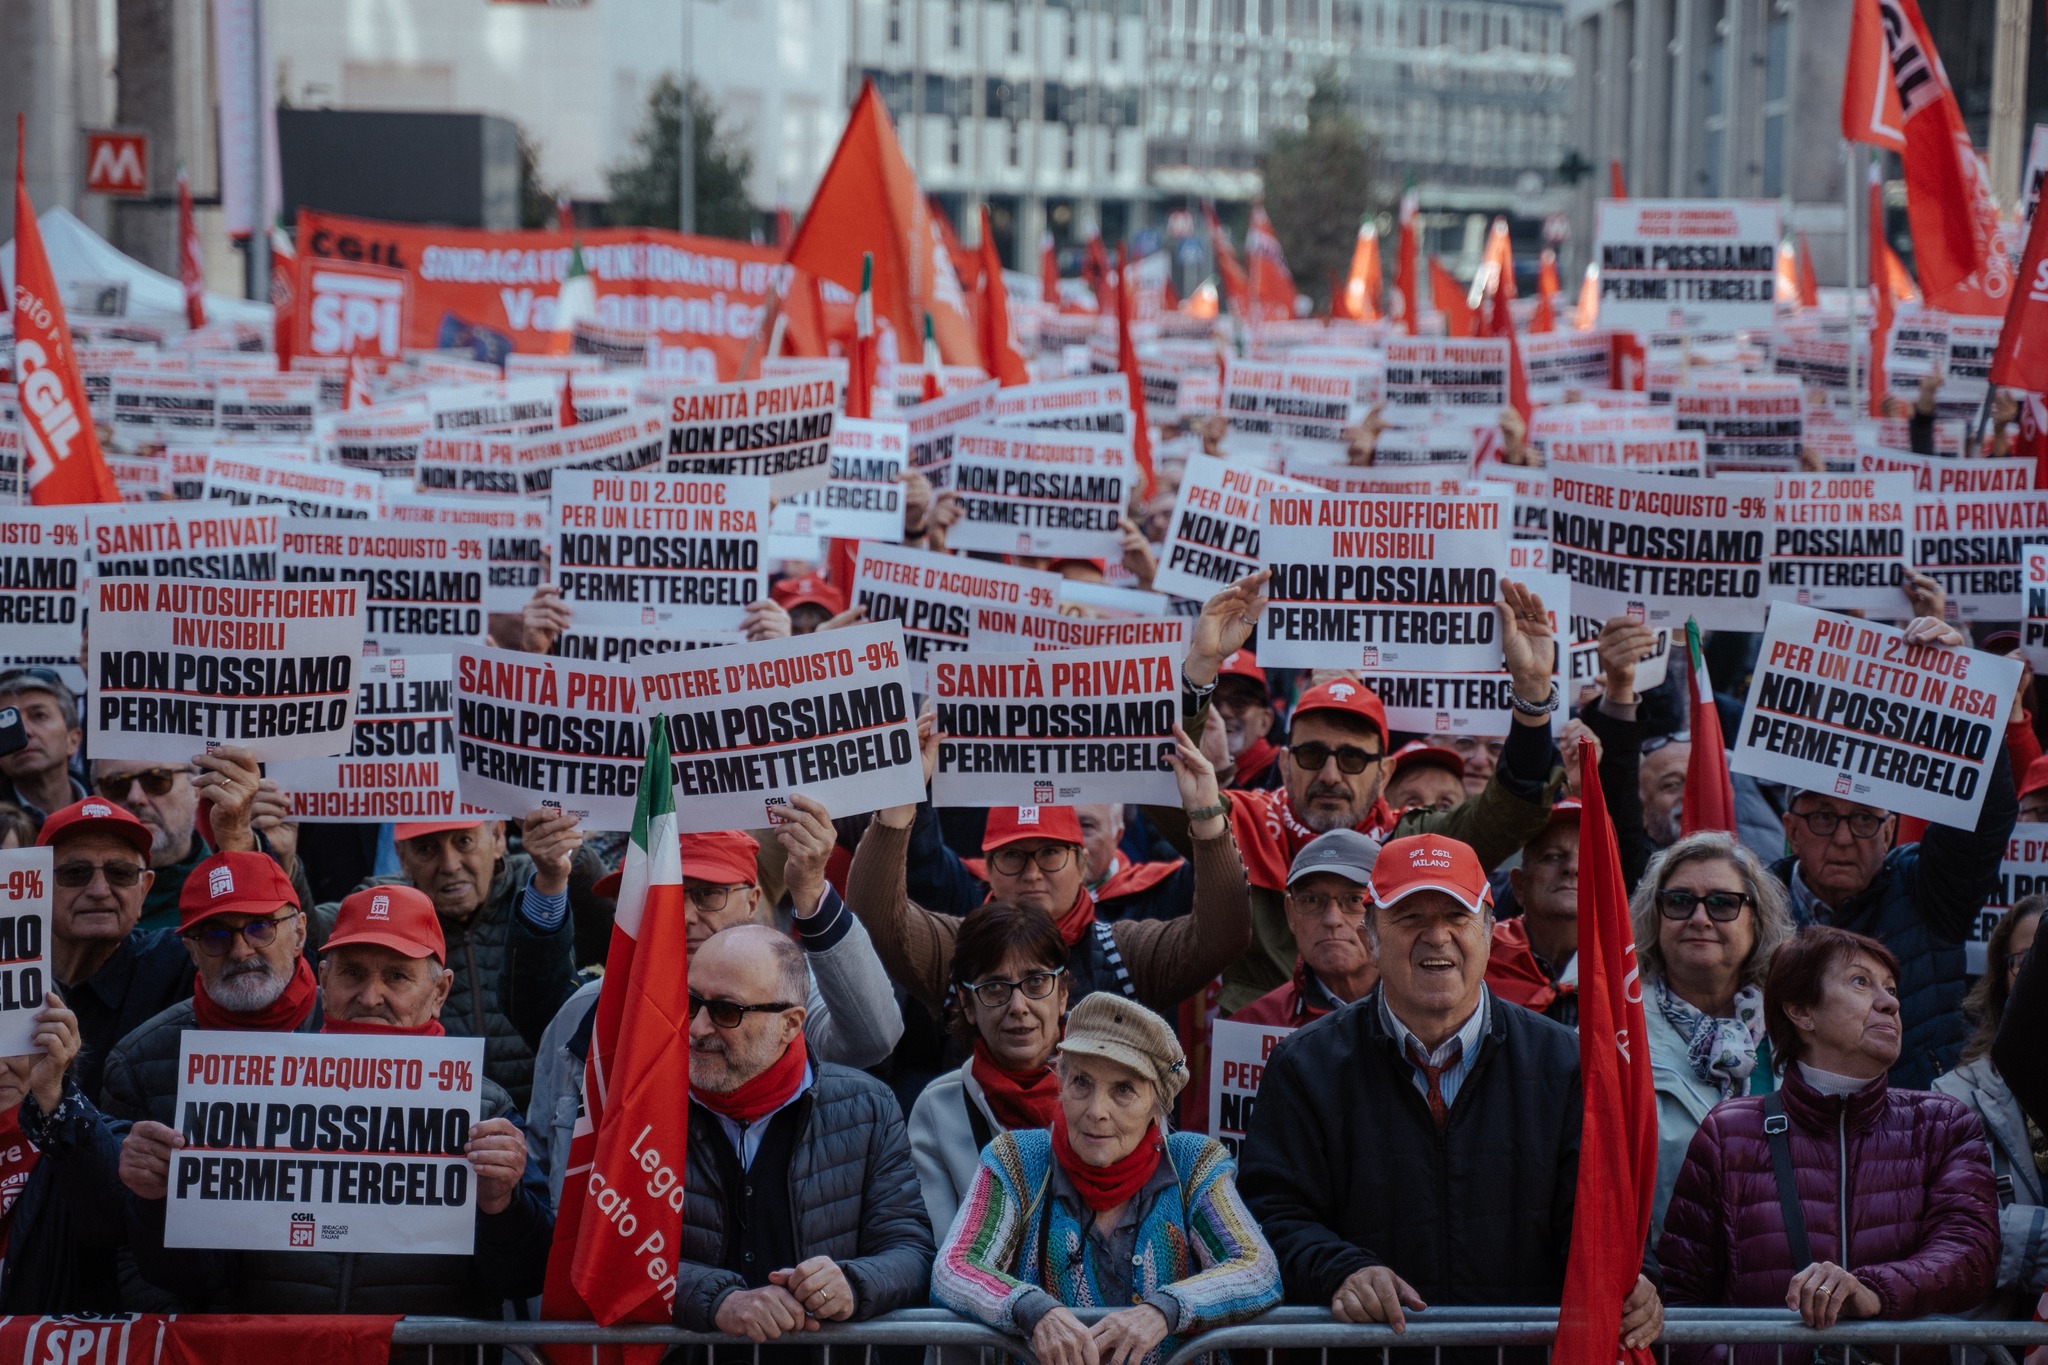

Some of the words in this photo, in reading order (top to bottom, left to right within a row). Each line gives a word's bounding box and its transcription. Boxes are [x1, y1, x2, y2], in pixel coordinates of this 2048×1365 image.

[1881, 3, 1931, 111] GIL
[89, 142, 144, 186] M
[310, 230, 407, 268] CGIL
[1652, 245, 1773, 271] POSSIAMO
[1602, 279, 1773, 302] PERMETTERCELO
[311, 294, 401, 357] SPI
[1386, 343, 1437, 363] SANITÀ
[1443, 345, 1505, 364] PRIVATA
[15, 338, 82, 462] CGIL
[672, 387, 748, 423] SANITÀ
[755, 380, 835, 416] PRIVATA
[422, 437, 483, 463] SANITÀ
[668, 425, 715, 455] NON
[720, 411, 833, 452] POSSIAMO
[958, 436, 1006, 458] POTERE
[1011, 440, 1094, 466] D'ACQUISTO
[1099, 447, 1123, 466] -9%
[1552, 440, 1617, 463] SANITÀ
[1623, 441, 1698, 463] PRIVATA
[421, 466, 456, 488] NON
[592, 476, 624, 502] PIÙ
[629, 480, 648, 503] DI
[654, 480, 726, 505] 2.000€
[956, 464, 999, 492] NON
[1004, 469, 1121, 504] POSSIAMO
[1788, 480, 1806, 499] DI
[1811, 479, 1875, 500] 2.000€
[1939, 467, 2028, 493] PRIVATA
[1187, 486, 1220, 509] PER
[1224, 495, 1249, 519] UN
[1269, 498, 1313, 527] NON
[1318, 500, 1498, 531] AUTOSUFFICIENTI
[1553, 477, 1614, 510] POTERE
[1619, 489, 1728, 519] D'ACQUISTO
[1732, 498, 1766, 519] -9%
[1790, 504, 1841, 523] LETTO
[1846, 504, 1864, 523] IN
[1868, 503, 1903, 523] RSA
[45, 524, 78, 546] -9%
[96, 516, 182, 555] SANITÀ
[561, 505, 596, 528] PER
[602, 506, 630, 529] UN
[633, 507, 688, 531] LETTO
[694, 510, 713, 532] IN
[718, 510, 757, 533] RSA
[1177, 510, 1227, 548] NON
[1552, 510, 1605, 552] NON
[1609, 522, 1764, 565] POSSIAMO
[283, 532, 344, 556] POTERE
[350, 535, 447, 560] D'ACQUISTO
[451, 539, 482, 560] -9%
[560, 533, 611, 566] NON
[616, 535, 759, 572] POSSIAMO
[1332, 531, 1435, 561] INVISIBILI
[1775, 528, 1904, 556] POSSIAMO
[559, 571, 758, 606] PERMETTERCELO
[862, 558, 919, 586] POTERE
[924, 567, 1020, 603] D'ACQUISTO
[1023, 586, 1055, 609] -9%
[1268, 563, 1330, 602] NON
[1334, 564, 1497, 605] POSSIAMO
[1552, 548, 1760, 599] PERMETTERCELO
[100, 583, 149, 613] NON
[155, 583, 356, 619] AUTOSUFFICIENTI
[172, 616, 286, 651] INVISIBILI
[977, 608, 1017, 634] NON
[1021, 613, 1183, 647] AUTOSUFFICIENTI
[1267, 607, 1495, 645] PERMETTERCELO
[1812, 618, 1855, 651] PIÙ
[1855, 629, 1883, 656] DI
[1882, 636, 1971, 681] 2.000€
[99, 651, 171, 691] NON
[174, 655, 352, 697] POSSIAMO
[459, 654, 559, 708] SANITÀ
[641, 667, 722, 703] POTERE
[724, 648, 855, 695] D'ACQUISTO
[857, 640, 900, 672] -9%
[936, 657, 1044, 698] SANITÀ
[1051, 655, 1175, 697] PRIVATA
[1769, 640, 1813, 674] PER
[1816, 651, 1851, 682] UN
[1851, 660, 1917, 698] LETTO
[1920, 677, 1948, 706] IN
[1948, 684, 1998, 720] RSA
[99, 696, 348, 740] PERMETTERCELO
[458, 698, 516, 746] NON
[721, 681, 906, 749] POSSIAMO
[936, 702, 1001, 738] NON
[1006, 698, 1175, 739] POSSIAMO
[1756, 671, 1826, 721] NON
[1823, 687, 1993, 761] POSSIAMO
[337, 761, 439, 789] INVISIBILI
[938, 742, 1177, 774] PERMETTERCELO
[1746, 714, 1980, 802] PERMETTERCELO
[541, 799, 562, 808] CGIL
[764, 796, 787, 806] CGIL
[1021, 808, 1036, 819] SPI
[209, 865, 231, 879] CGIL
[1409, 849, 1425, 858] SPI
[1431, 849, 1453, 859] CGIL
[1412, 858, 1450, 868] MILANO
[211, 879, 233, 895] SPI
[373, 904, 387, 913] SPI
[187, 1053, 276, 1086] POTERE
[280, 1056, 423, 1092] D'ACQUISTO
[428, 1060, 473, 1092] -9%
[184, 1101, 260, 1150] NON
[264, 1103, 471, 1156] POSSIAMO
[176, 1156, 468, 1207] PERMETTERCELO
[291, 1212, 316, 1222] CGIL
[292, 1229, 313, 1245] SPI
[43, 1326, 112, 1365] SPI
